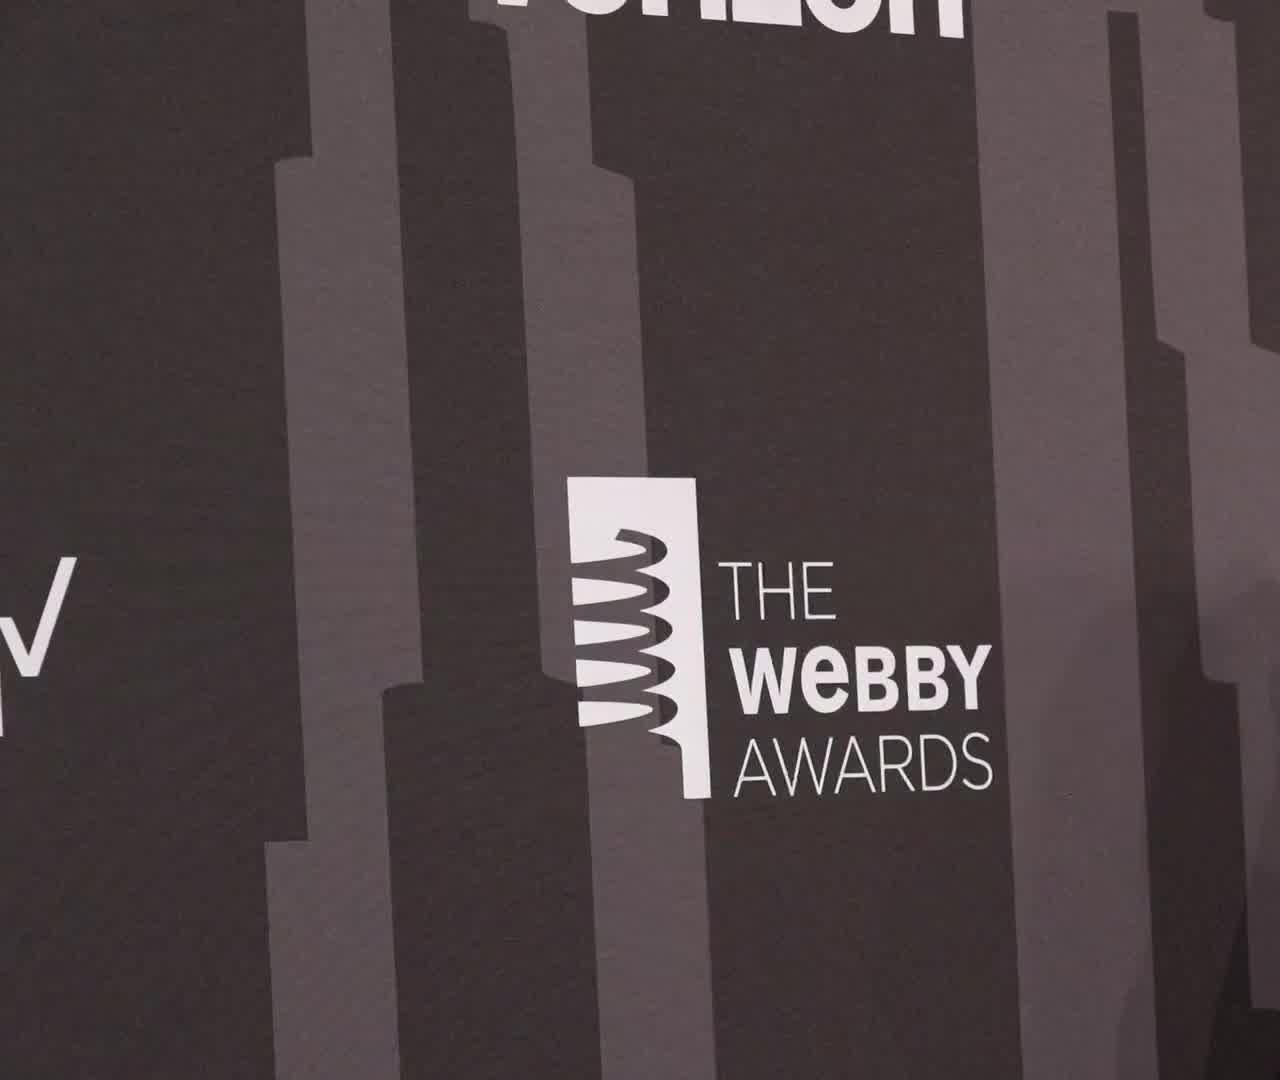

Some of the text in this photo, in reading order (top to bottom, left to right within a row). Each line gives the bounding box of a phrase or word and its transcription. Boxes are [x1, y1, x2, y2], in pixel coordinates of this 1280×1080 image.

[718, 561, 837, 621] THE
[728, 644, 993, 715] WeBBY
[733, 732, 993, 798] AWARDS
